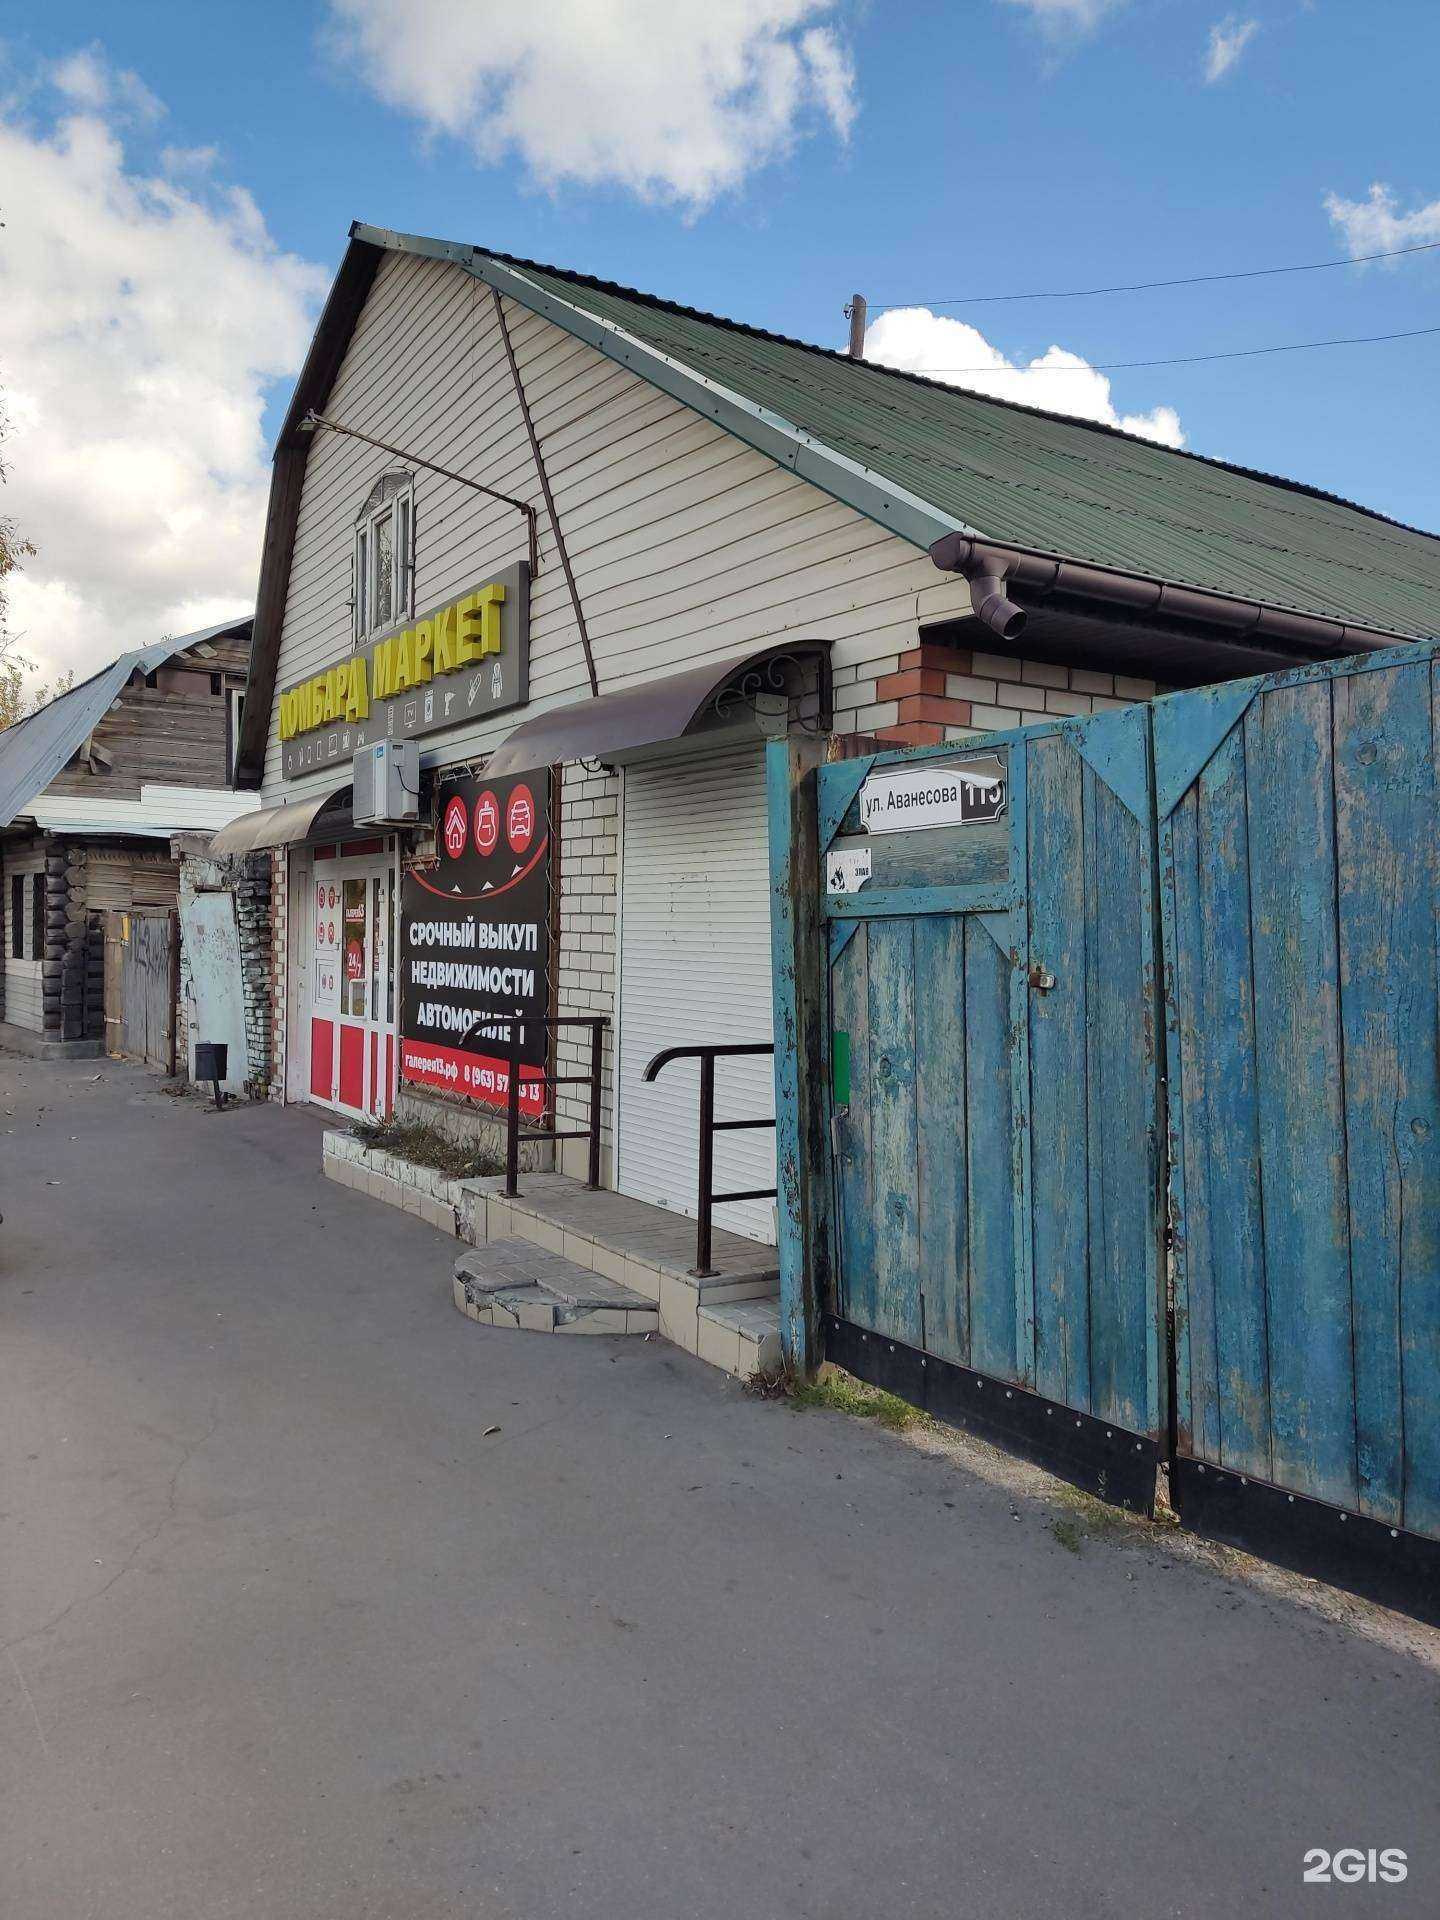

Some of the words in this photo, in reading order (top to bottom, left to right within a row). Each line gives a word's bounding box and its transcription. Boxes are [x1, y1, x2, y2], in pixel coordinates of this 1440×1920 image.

[279, 656, 369, 741] ЛОМБАРД
[373, 583, 506, 700] МАРКЕТ
[865, 796, 884, 818] ул.
[886, 785, 958, 810] Аванесова
[409, 915, 476, 948] СРОЧНЫЙ
[478, 923, 538, 951] ВЫКУП
[411, 960, 535, 997] НЕДВИЖИМОСТИ
[405, 1054, 458, 1083] галерея13.рф
[464, 1064, 471, 1082] 8
[472, 1065, 495, 1093] (963)
